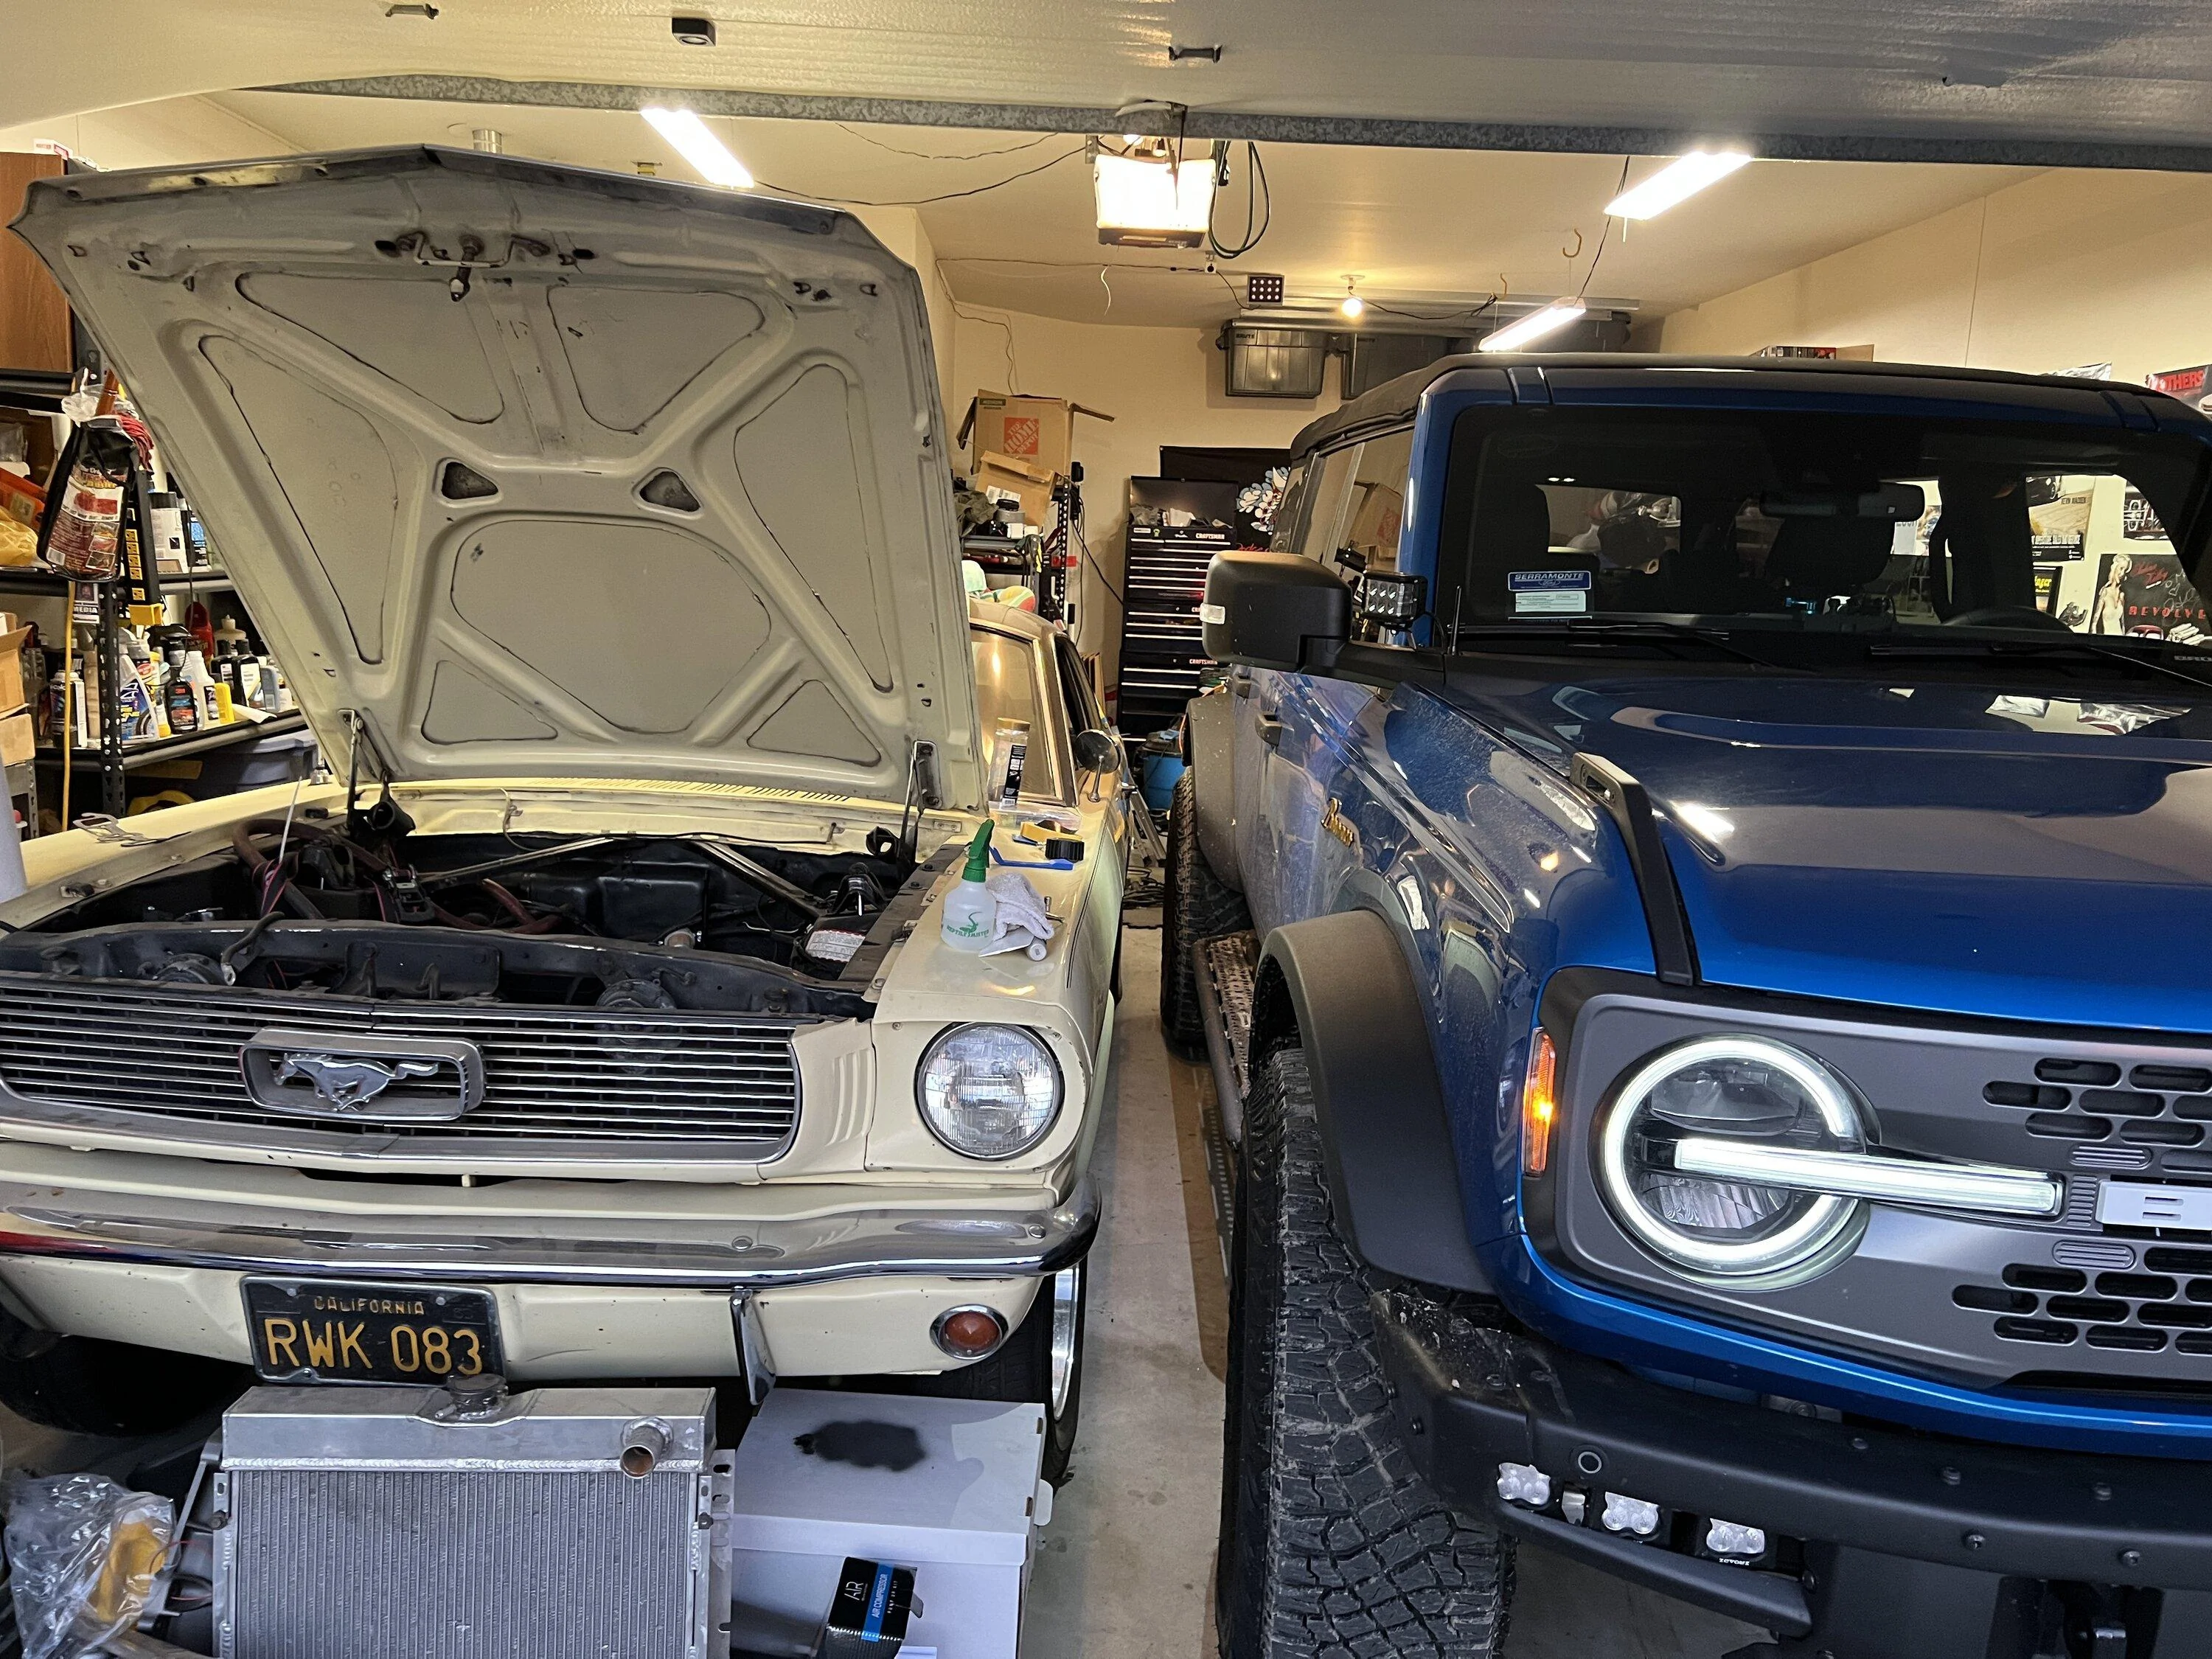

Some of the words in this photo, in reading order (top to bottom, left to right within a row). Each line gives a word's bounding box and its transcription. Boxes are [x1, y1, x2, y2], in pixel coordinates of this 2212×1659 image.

[1004, 418, 1040, 454] HOME
[1515, 572, 1585, 580] SERRAMONTE
[2129, 605, 2206, 619] REVOLVE
[313, 1295, 425, 1315] CALIFORNIA
[264, 1318, 373, 1369] RWK
[390, 1324, 483, 1376] 083
[873, 1573, 888, 1608] COMPRESSOR
[872, 1607, 881, 1618] AIR
